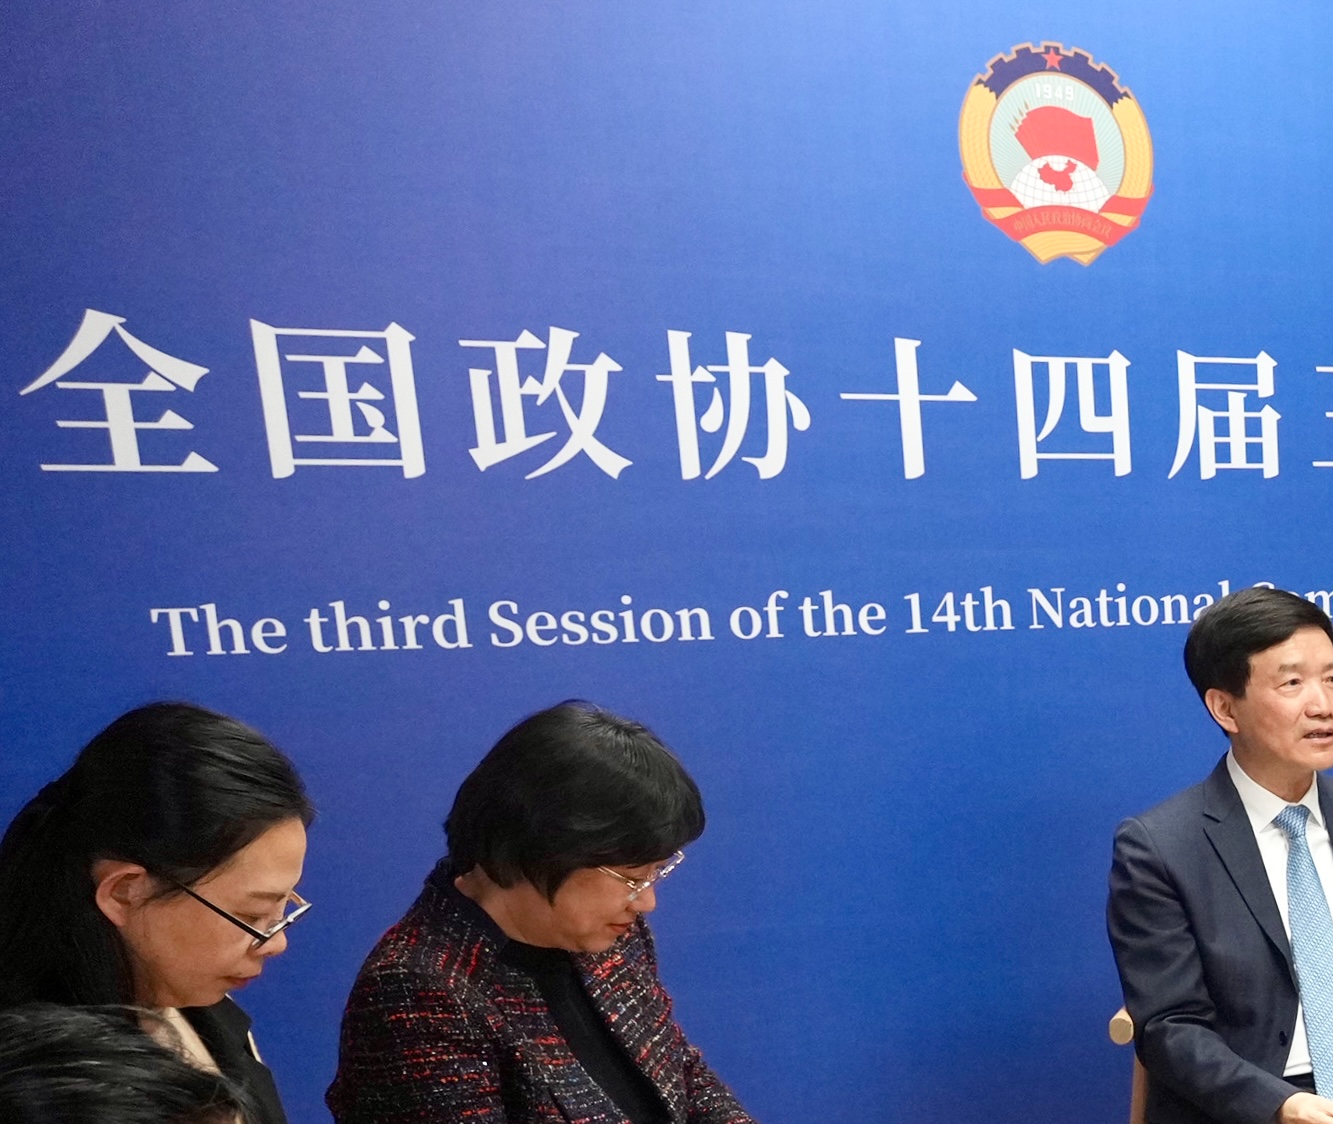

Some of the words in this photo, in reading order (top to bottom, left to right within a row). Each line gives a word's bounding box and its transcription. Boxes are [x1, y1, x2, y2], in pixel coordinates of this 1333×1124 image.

[1034, 83, 1076, 101] 1949
[150, 603, 288, 656] The
[303, 598, 473, 653] third
[488, 594, 715, 648] Session
[729, 590, 789, 640] of
[798, 589, 887, 638] the
[903, 585, 1015, 634] 14th
